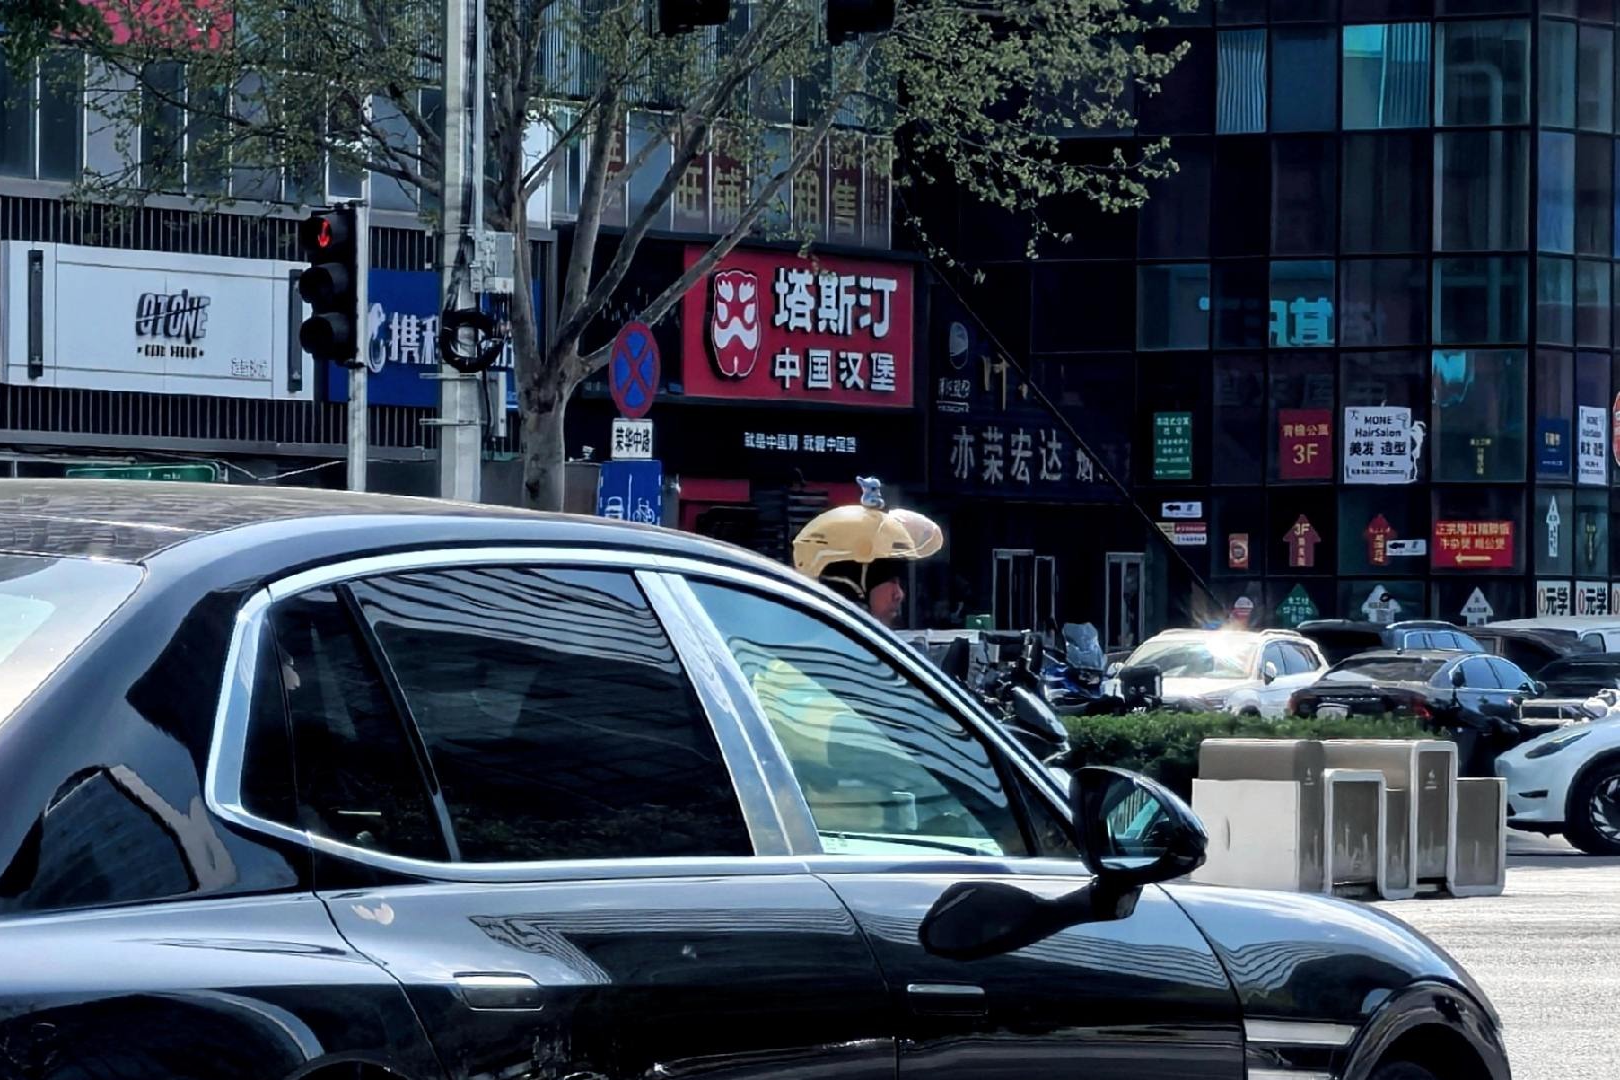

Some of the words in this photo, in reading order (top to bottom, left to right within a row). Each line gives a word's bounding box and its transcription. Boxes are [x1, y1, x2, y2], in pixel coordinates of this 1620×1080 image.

[775, 267, 898, 338] 塔斯汀
[775, 347, 897, 392] 中国汉堡
[1292, 443, 1319, 464] 3F
